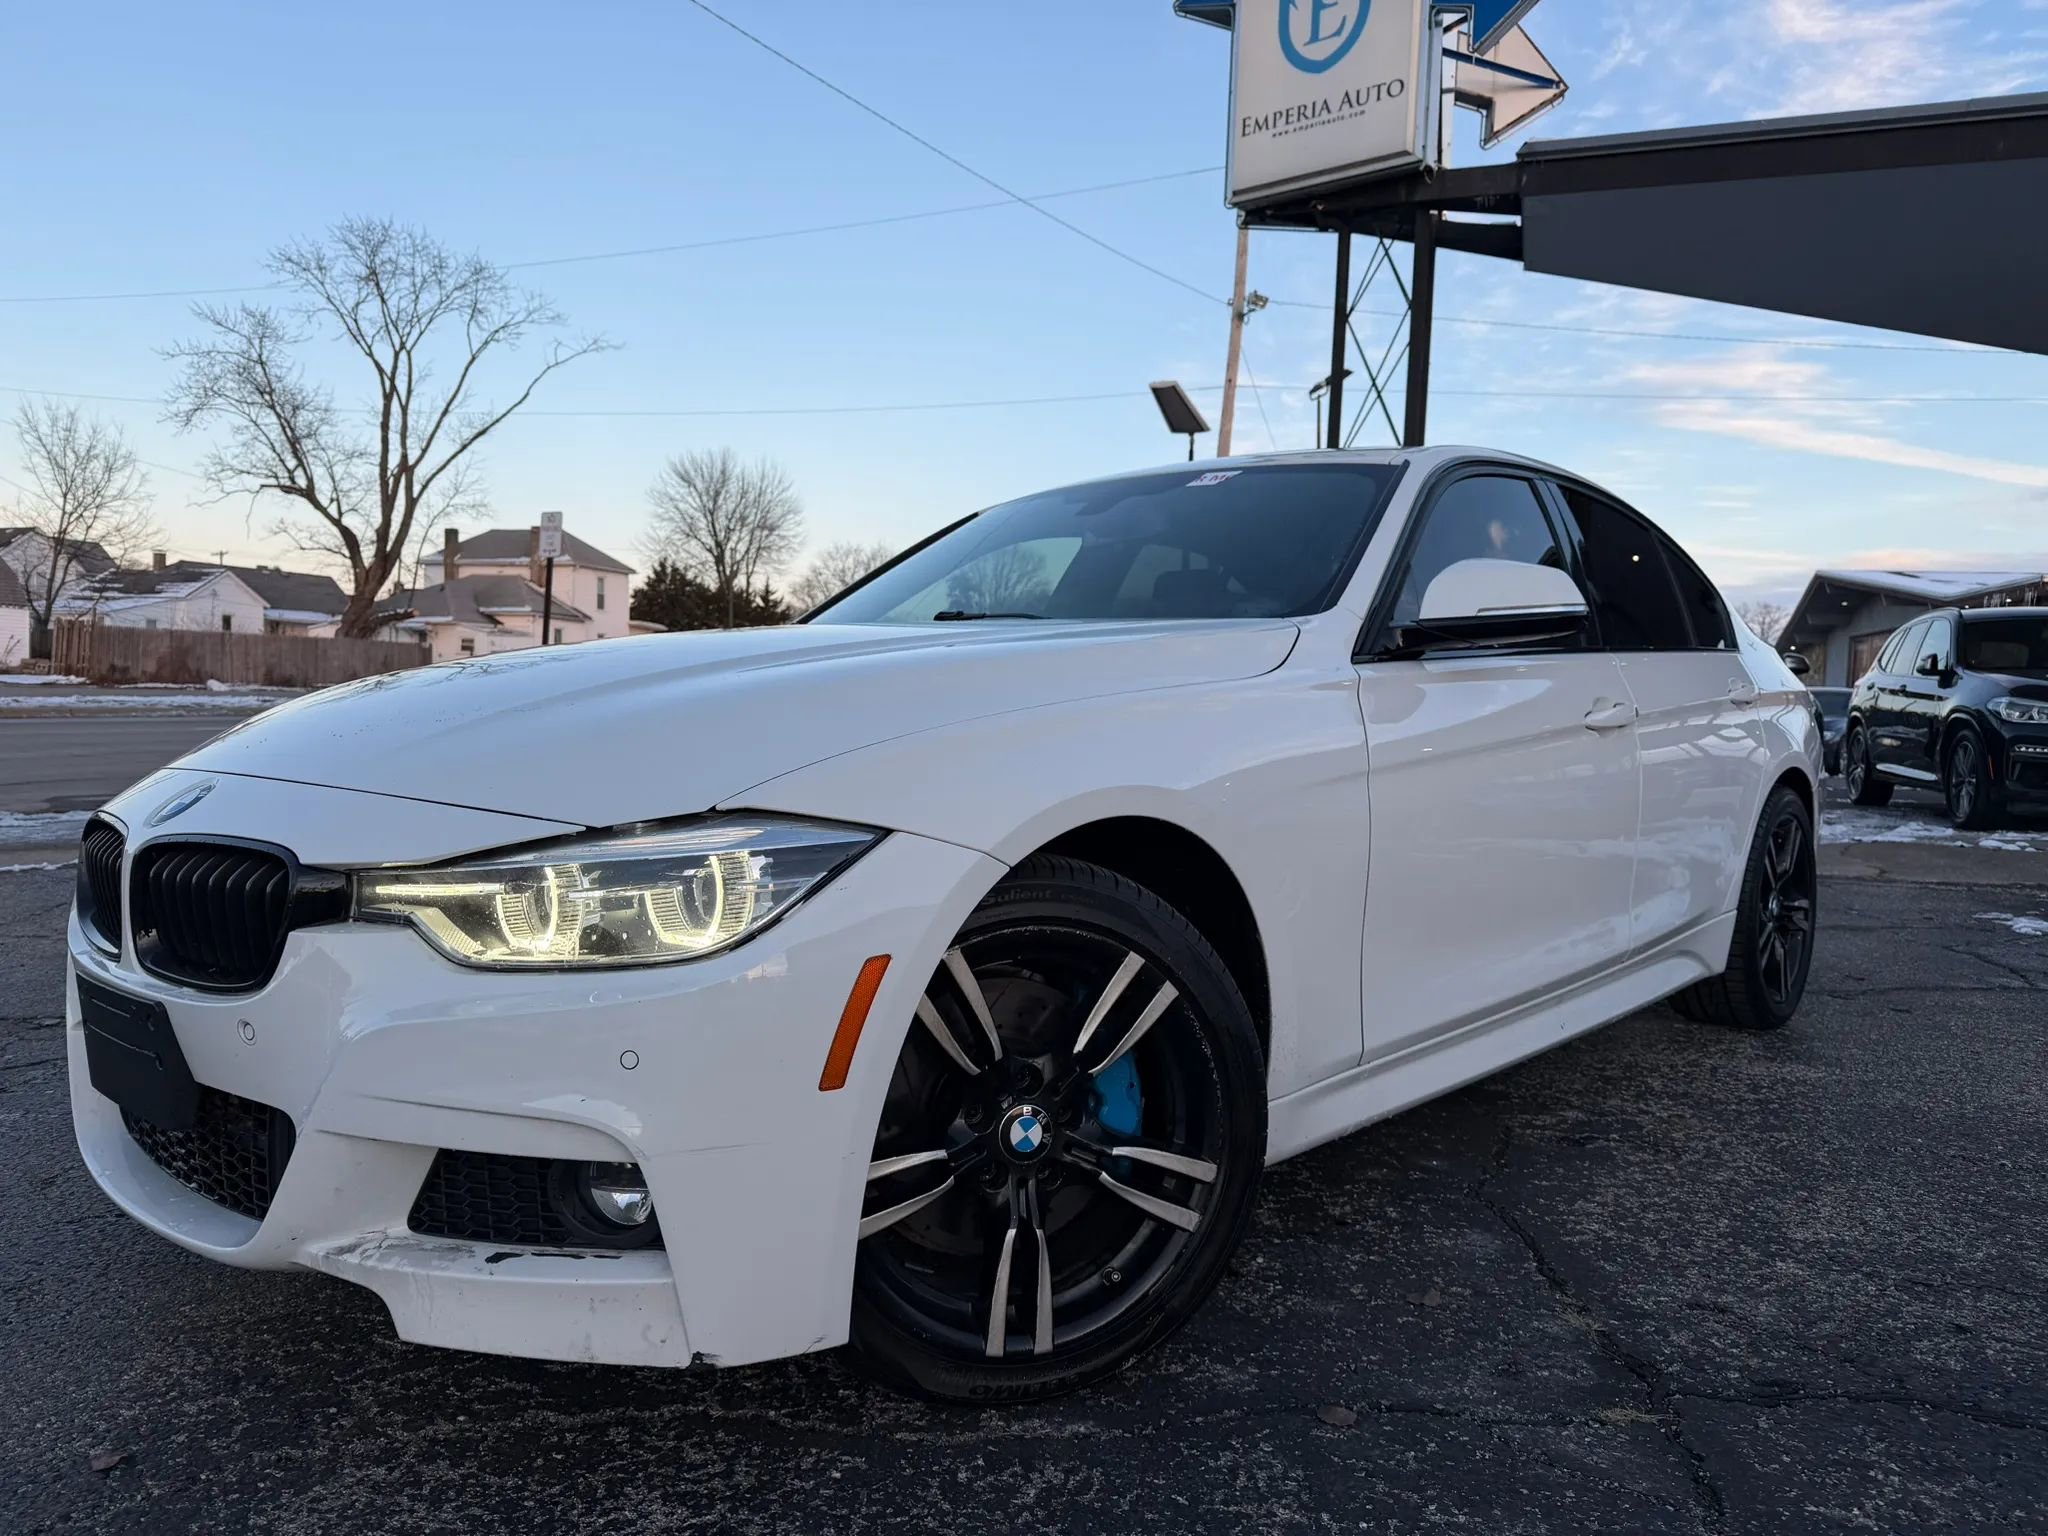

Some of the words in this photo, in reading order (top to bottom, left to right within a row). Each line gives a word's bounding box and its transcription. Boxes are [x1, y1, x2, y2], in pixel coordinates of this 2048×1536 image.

[1241, 97, 1332, 138] EMPERIA
[1338, 78, 1405, 113] AUTO
[1022, 1106, 1051, 1144] BMW
